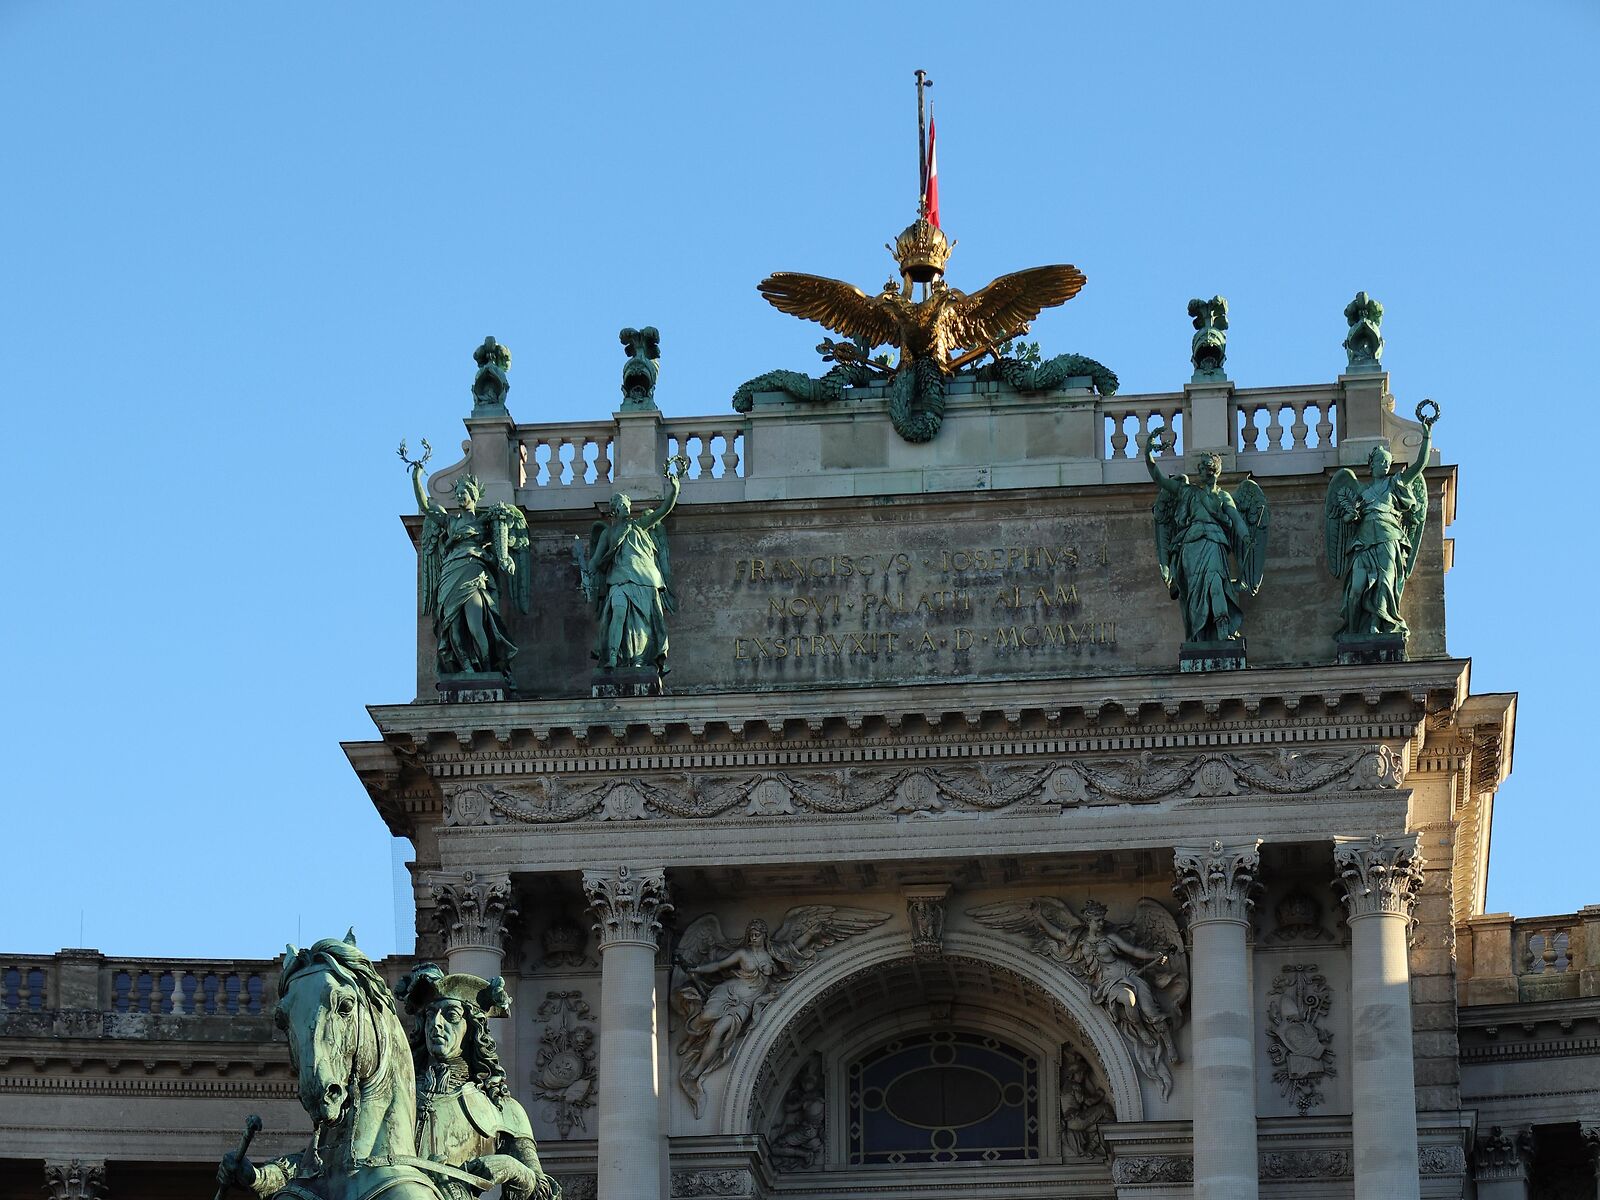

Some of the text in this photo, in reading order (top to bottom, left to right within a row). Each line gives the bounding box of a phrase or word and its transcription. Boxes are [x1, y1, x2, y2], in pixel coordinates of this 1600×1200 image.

[735, 553, 912, 581] FRANCISCVS
[941, 545, 1079, 571] IOSEPHVS
[767, 595, 841, 618] NOVI
[992, 583, 1079, 609] ALAM
[735, 632, 899, 660] EXSTRVXIT
[995, 622, 1117, 649] MCMVIII
